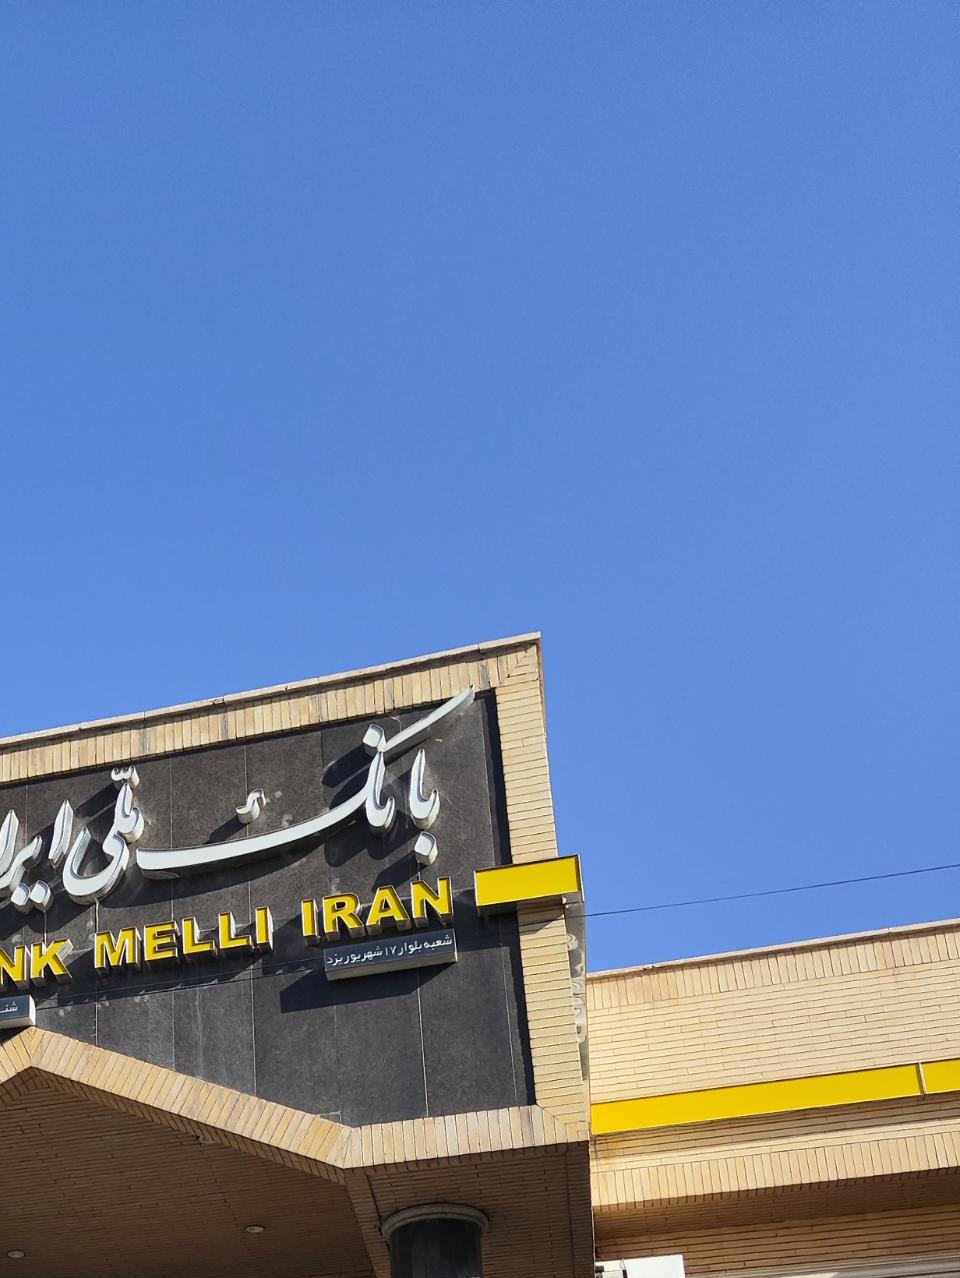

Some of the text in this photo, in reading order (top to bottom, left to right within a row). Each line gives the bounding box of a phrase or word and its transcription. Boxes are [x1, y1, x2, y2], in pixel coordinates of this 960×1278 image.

[136, 684, 476, 873] بانک
[94, 906, 272, 971] MELLI
[302, 877, 453, 938] IRAN
[397, 941, 422, 956] بلوار
[423, 933, 453, 950] شعبه
